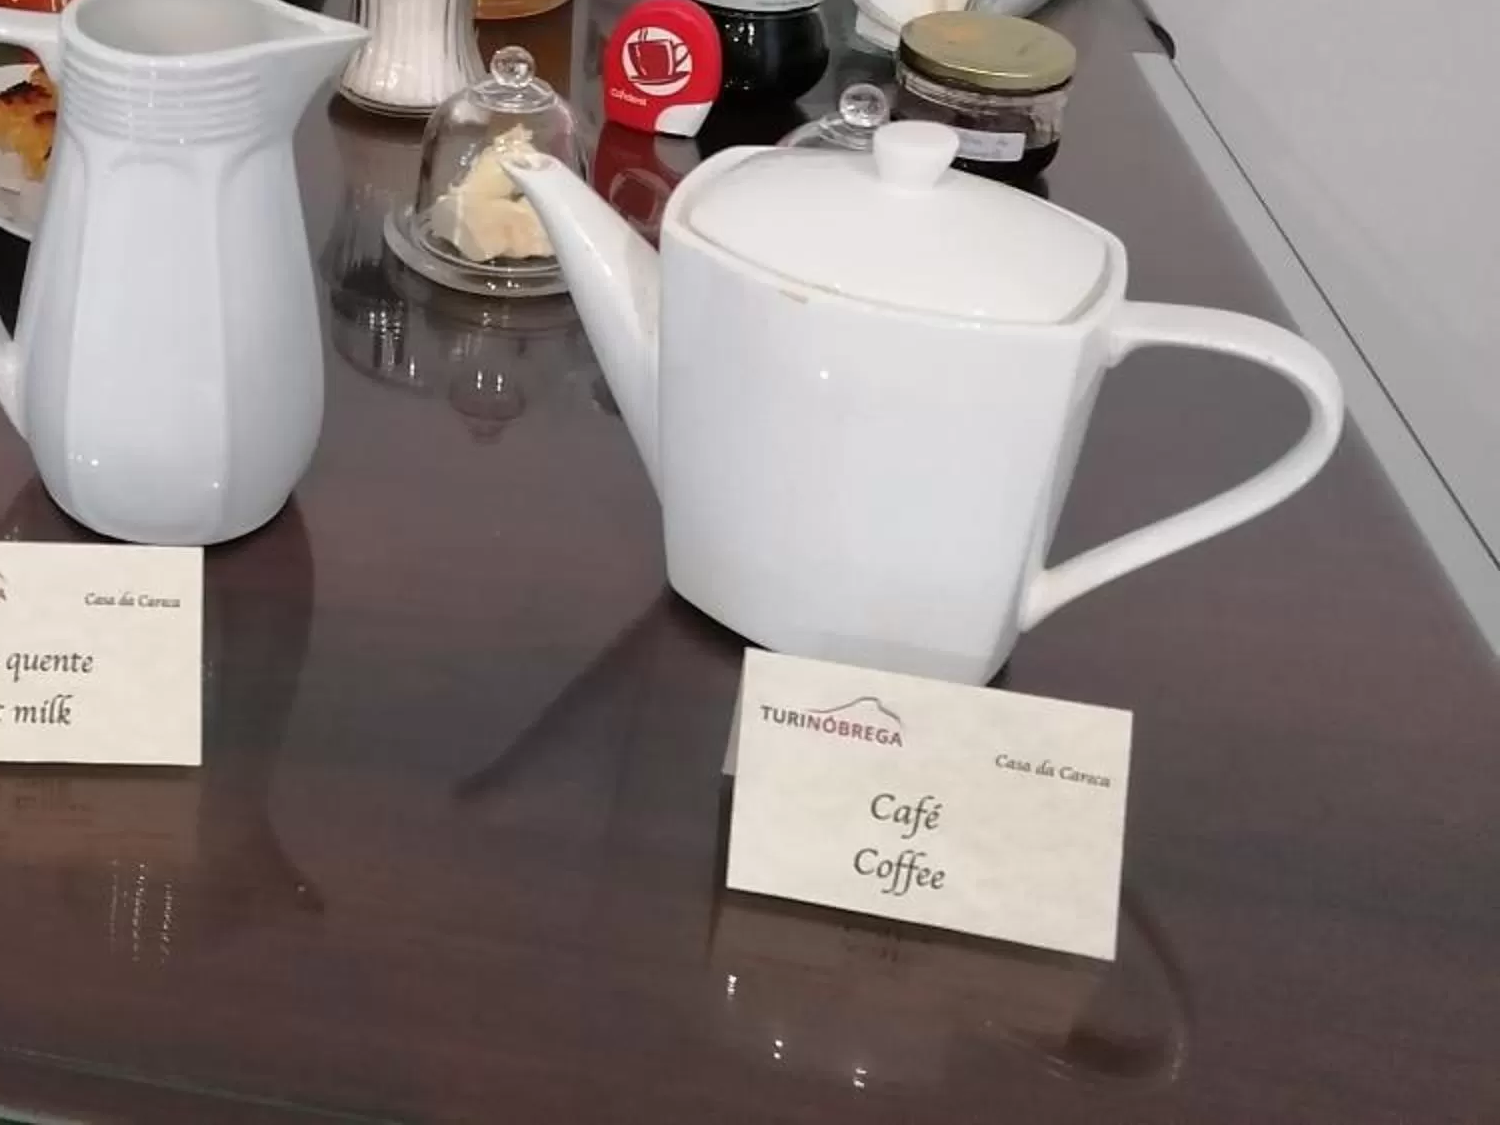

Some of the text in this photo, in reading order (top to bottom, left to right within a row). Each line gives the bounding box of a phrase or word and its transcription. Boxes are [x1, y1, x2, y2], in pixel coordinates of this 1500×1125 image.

[84, 592, 116, 606] Casa
[117, 590, 135, 606] da
[5, 649, 94, 683] quente
[13, 694, 74, 725] milk
[760, 704, 903, 748] TURINÓBREGA
[995, 754, 1032, 773] Casa
[1035, 759, 1055, 777] da
[870, 793, 944, 840] Café
[853, 847, 946, 896] Coffee
